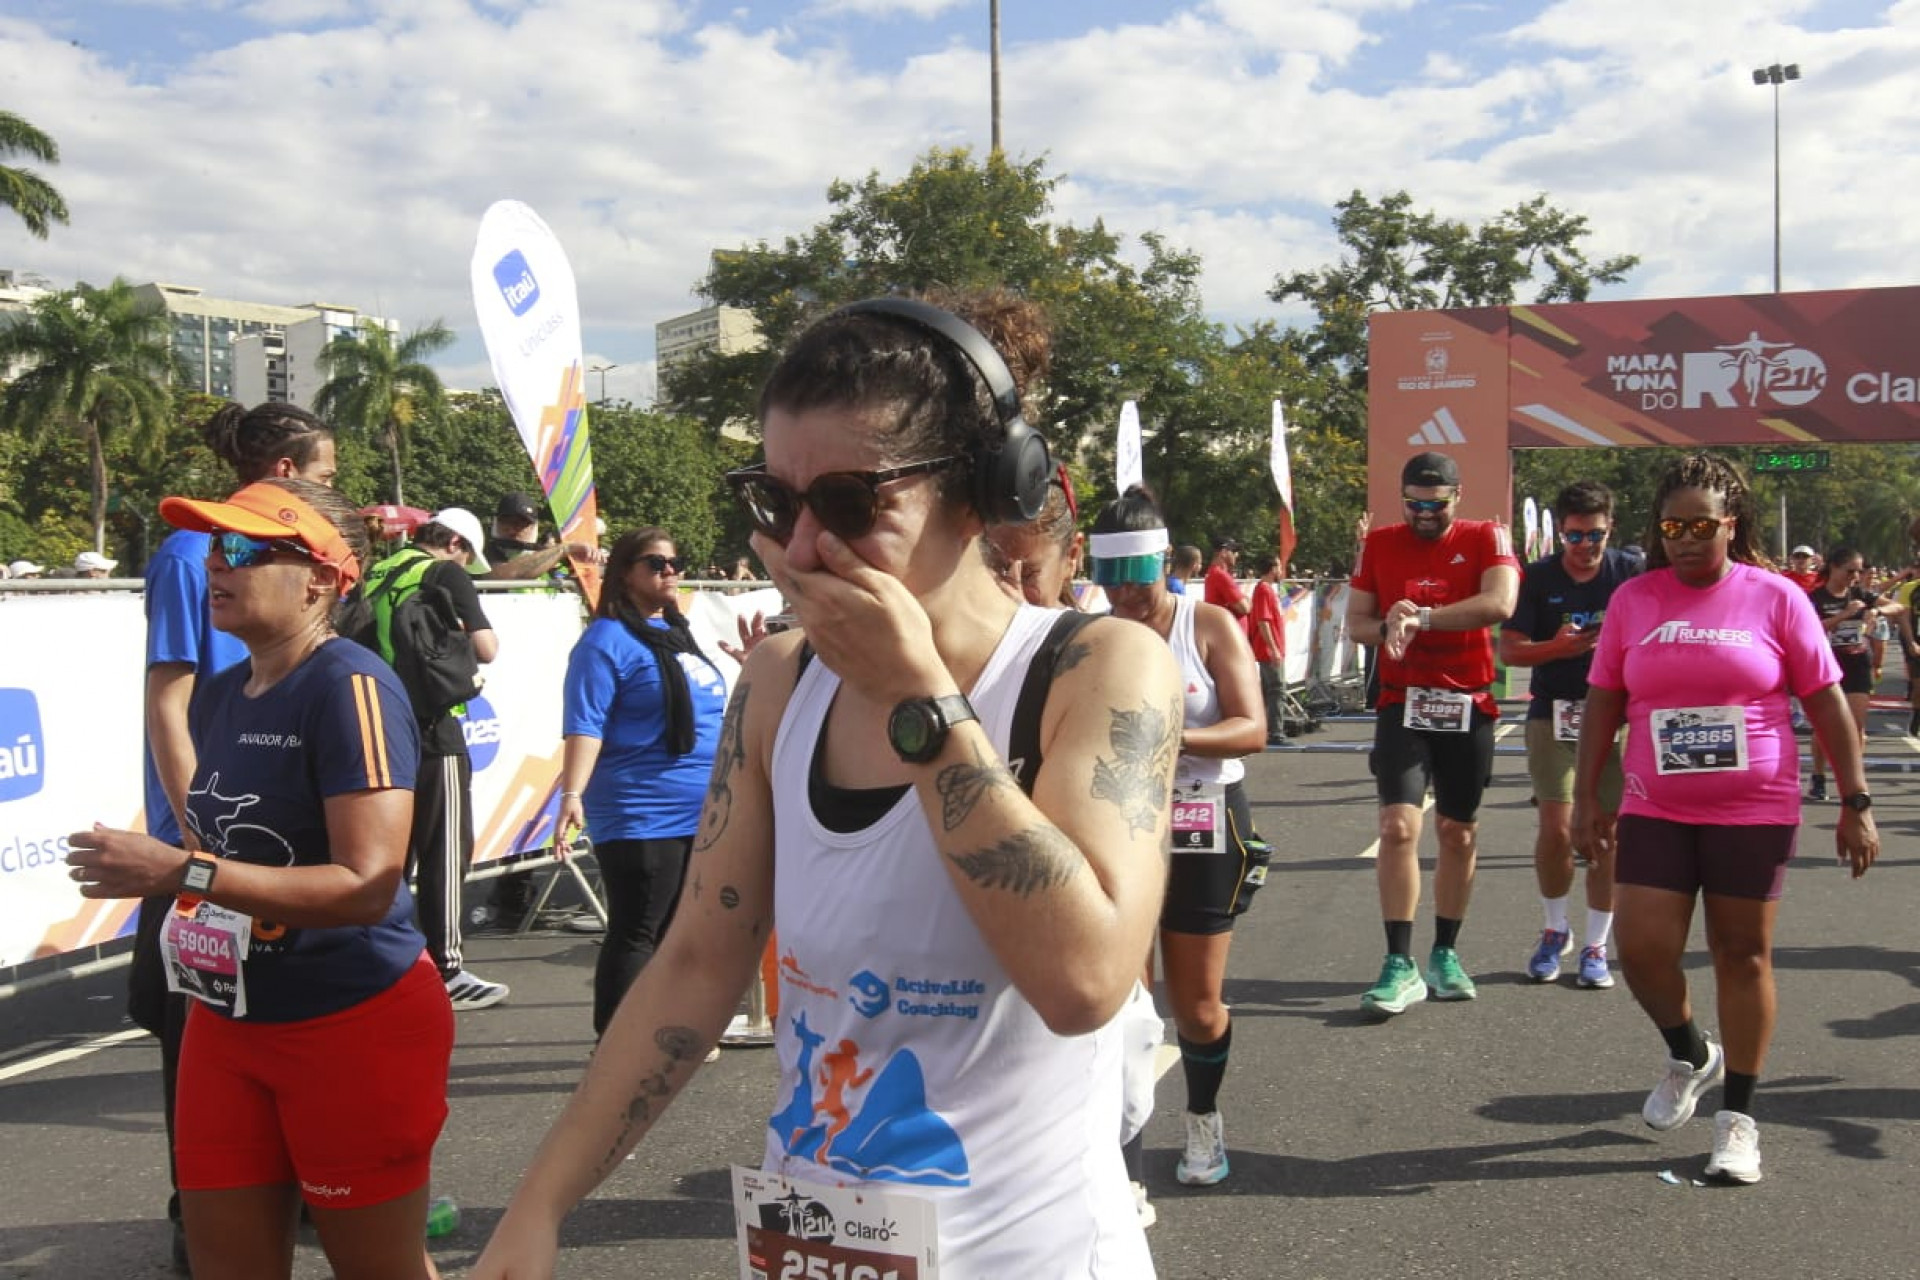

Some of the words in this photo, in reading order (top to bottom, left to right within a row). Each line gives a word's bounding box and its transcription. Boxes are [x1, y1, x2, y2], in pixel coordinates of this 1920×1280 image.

[503, 270, 536, 308] itaú
[518, 314, 565, 358] Uniclass
[1607, 354, 1678, 374] MARA
[1611, 373, 1678, 392] TONA
[1642, 393, 1678, 410] DO
[1678, 628, 1752, 642] RUNNERS
[1671, 729, 1733, 745] 23365
[178, 928, 231, 960] 59004
[896, 976, 986, 996] ActiveLife
[897, 998, 979, 1019] Coaching
[844, 1219, 890, 1242] Claro
[780, 1249, 899, 1280] 251
